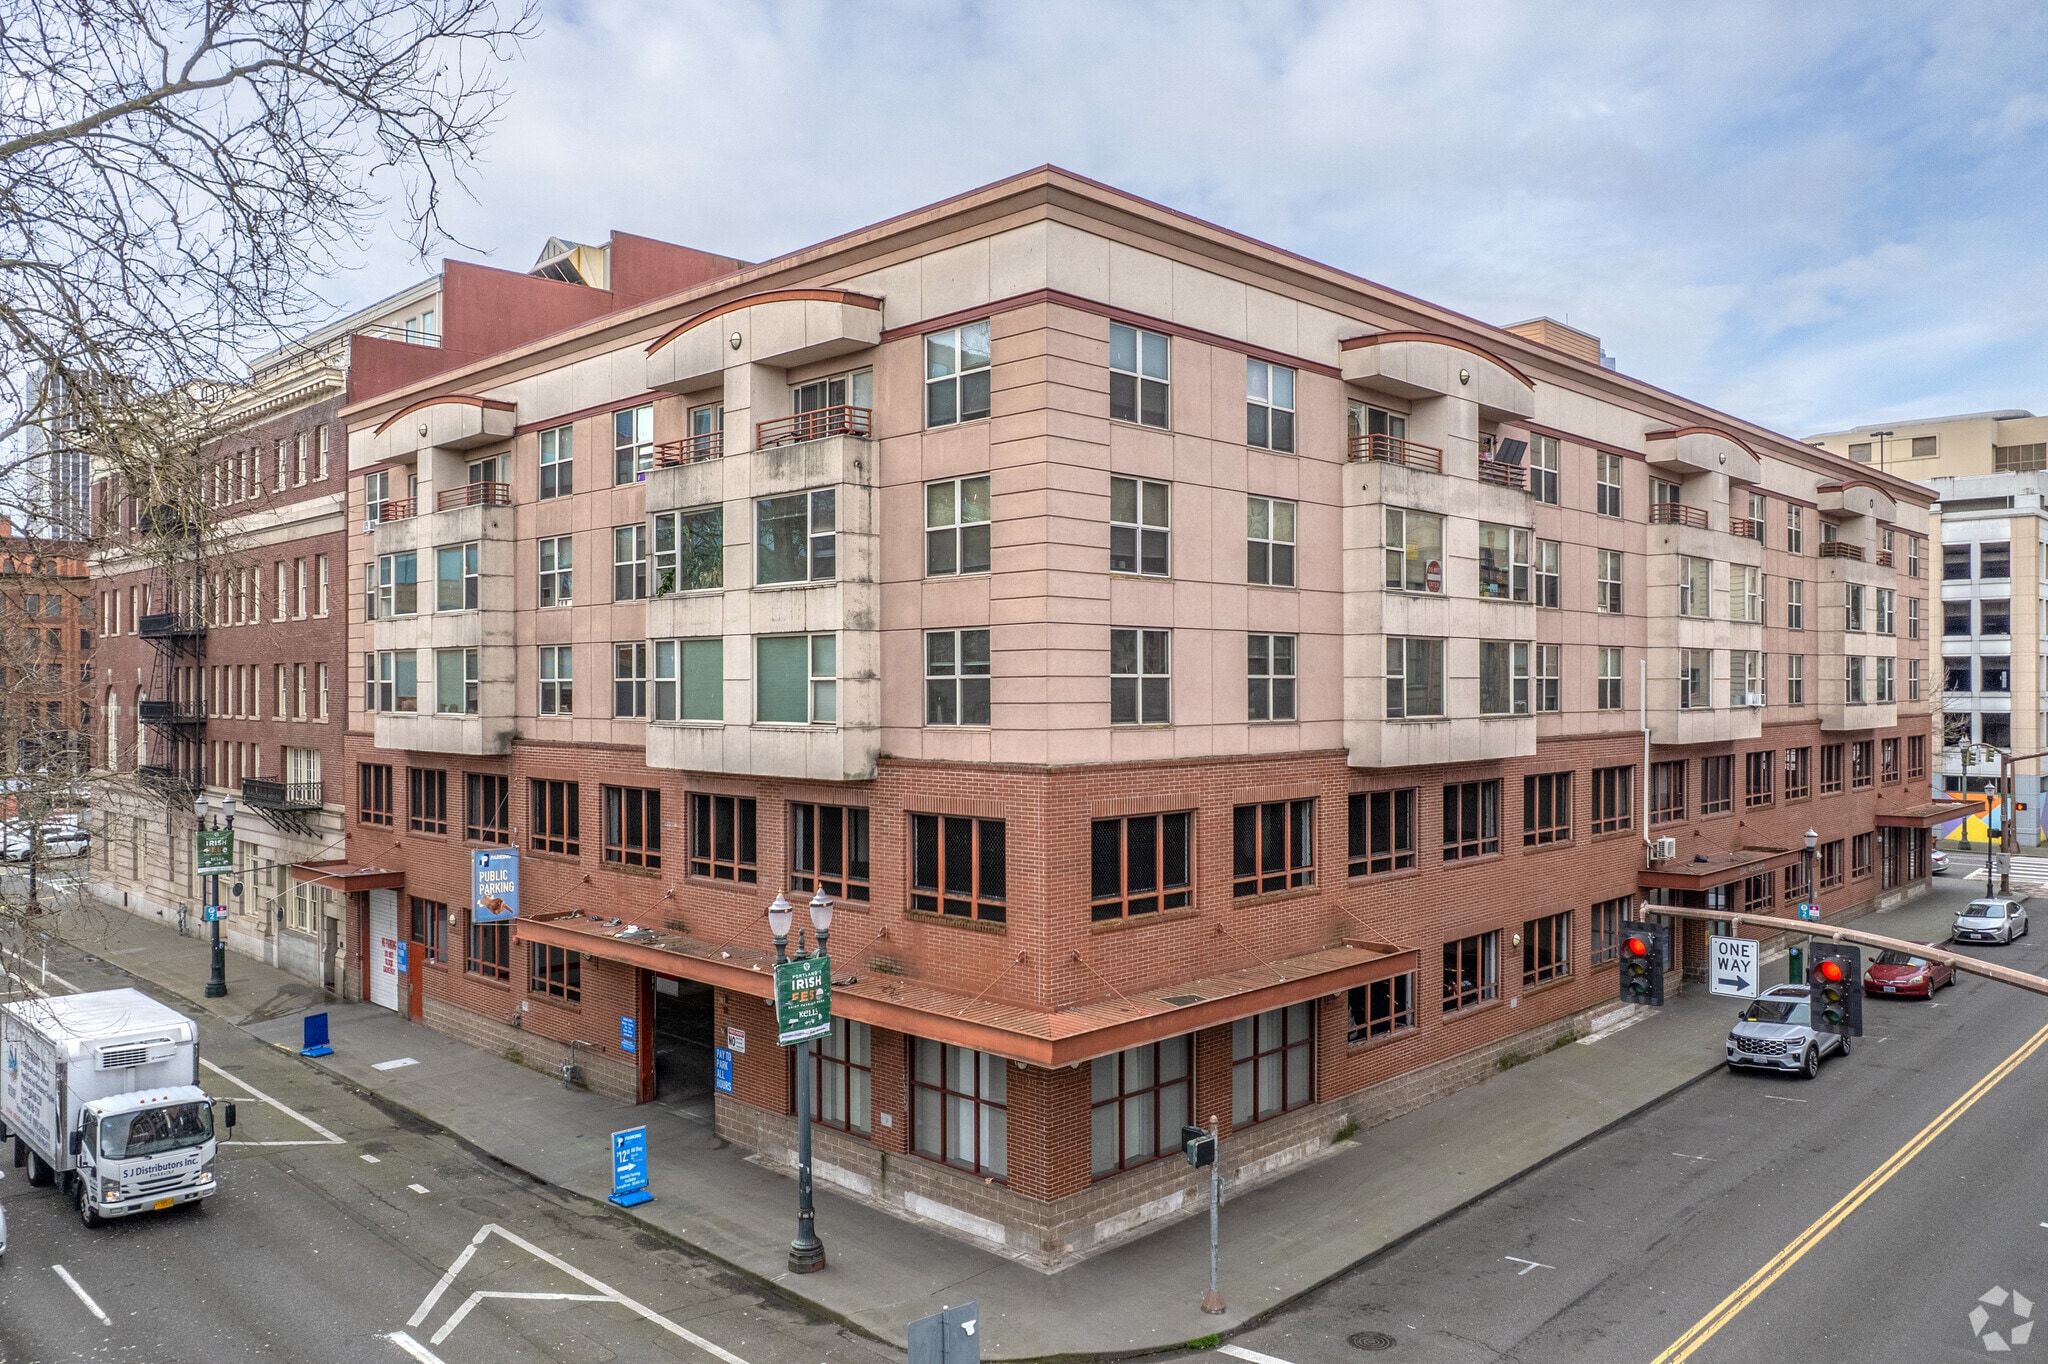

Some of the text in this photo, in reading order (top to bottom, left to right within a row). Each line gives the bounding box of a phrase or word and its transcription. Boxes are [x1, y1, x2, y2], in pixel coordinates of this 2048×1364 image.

[479, 870, 508, 882] PUBLIC
[479, 881, 514, 895] PARKING
[1718, 942, 1750, 958] ONE
[1717, 957, 1751, 973] WAY
[791, 975, 822, 991] IRISH
[791, 989, 818, 1002] FES
[728, 1035, 736, 1047] NO
[716, 1048, 732, 1062] PAY TO
[716, 1058, 728, 1071] PARK
[716, 1069, 725, 1080] ALL
[716, 1079, 732, 1092] HOURS
[123, 1158, 198, 1178] S J Distributors Inc.
